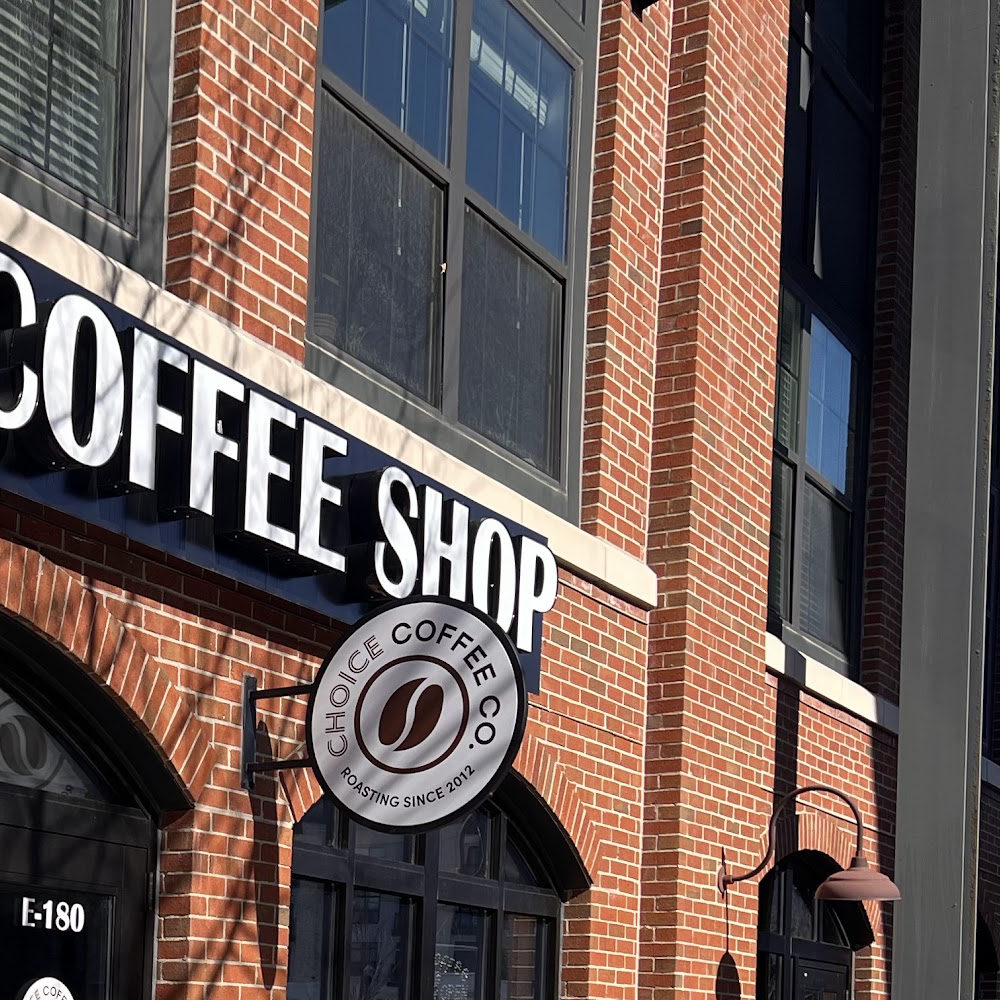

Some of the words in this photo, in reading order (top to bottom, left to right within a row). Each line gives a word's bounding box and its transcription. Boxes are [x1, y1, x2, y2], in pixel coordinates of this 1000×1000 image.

[374, 466, 558, 652] SHOP
[325, 635, 384, 757] CHOICE
[391, 620, 497, 687] COFFEE
[469, 695, 501, 750] CO.
[340, 766, 400, 808] ROASTING
[403, 789, 445, 808] SINCE
[446, 764, 476, 793] 2012
[22, 896, 85, 932] E-180
